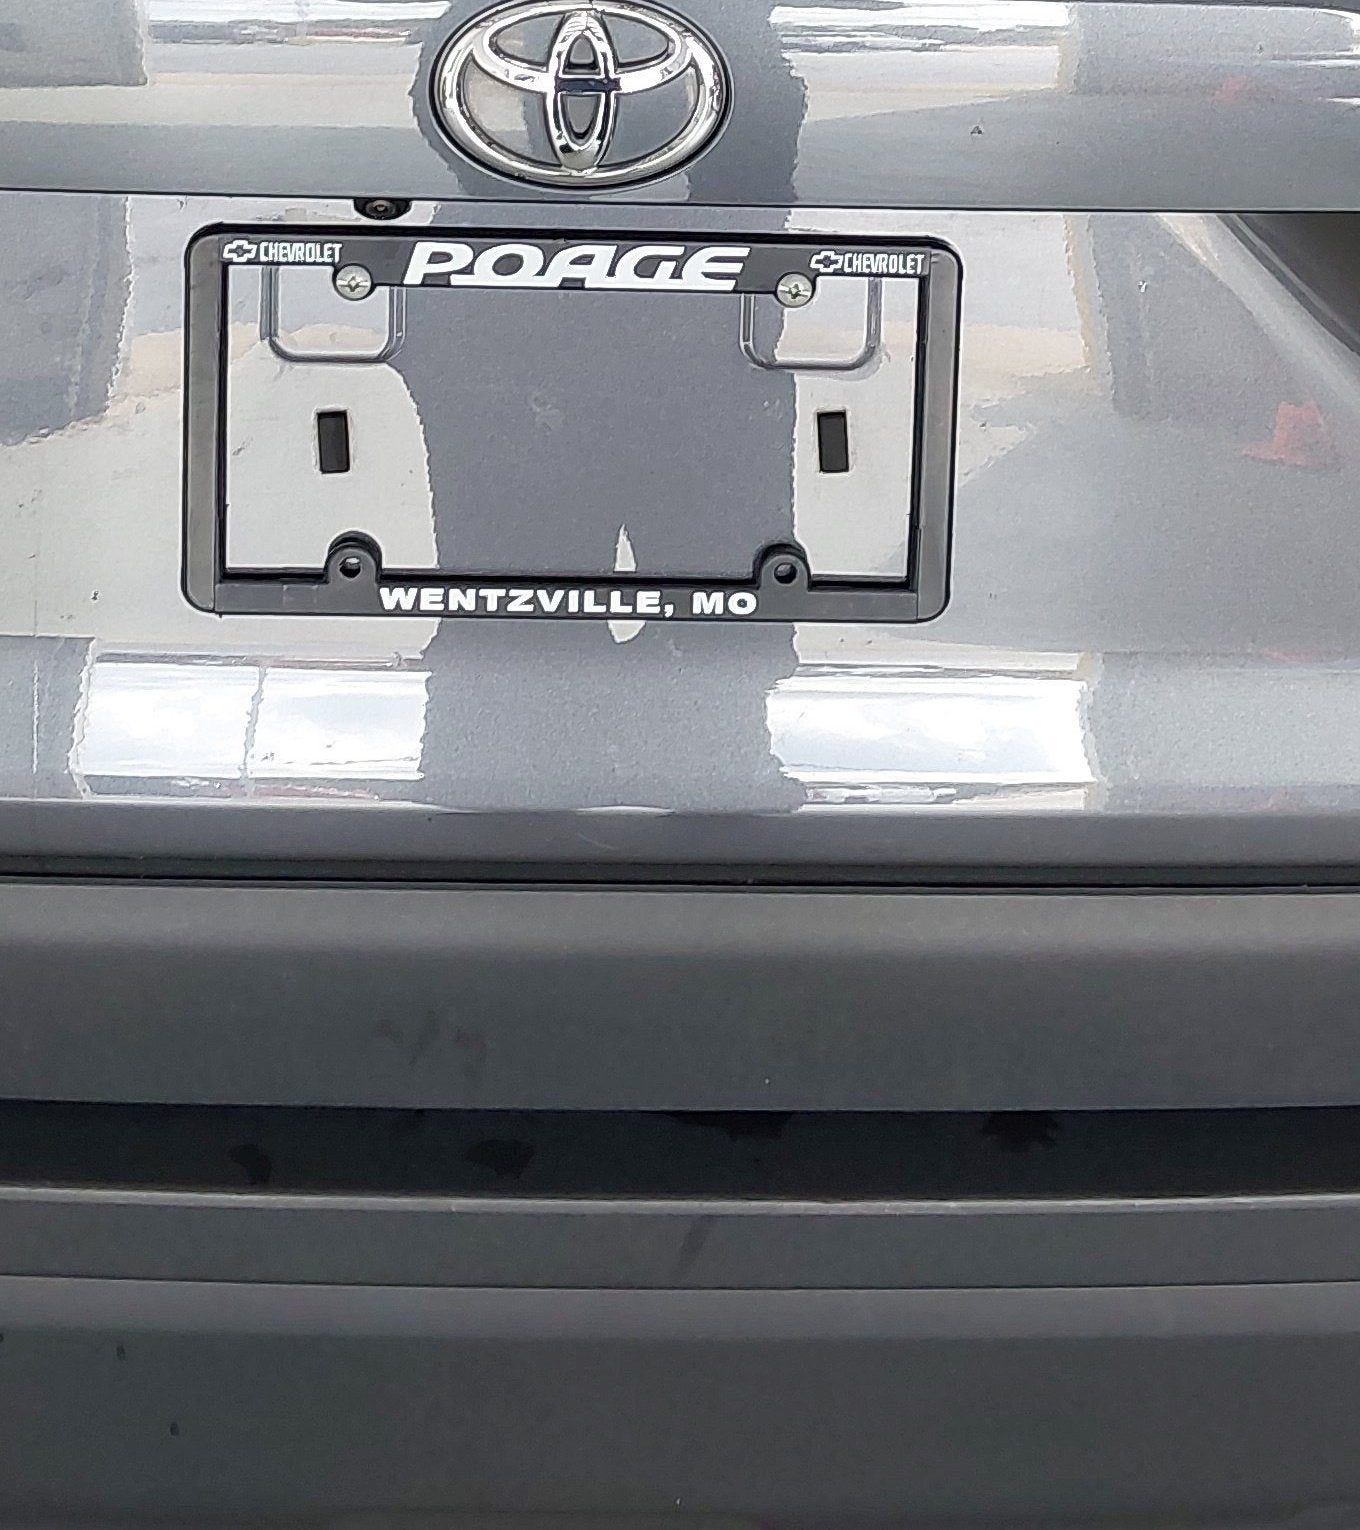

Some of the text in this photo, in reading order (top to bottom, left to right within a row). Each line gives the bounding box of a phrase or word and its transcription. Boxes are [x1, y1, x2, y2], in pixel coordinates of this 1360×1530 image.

[259, 241, 343, 264] CHEVROLET
[403, 240, 751, 291] POAGE
[843, 252, 925, 275] CHEVROLET
[379, 586, 758, 618] WENTZVILLE, MO
